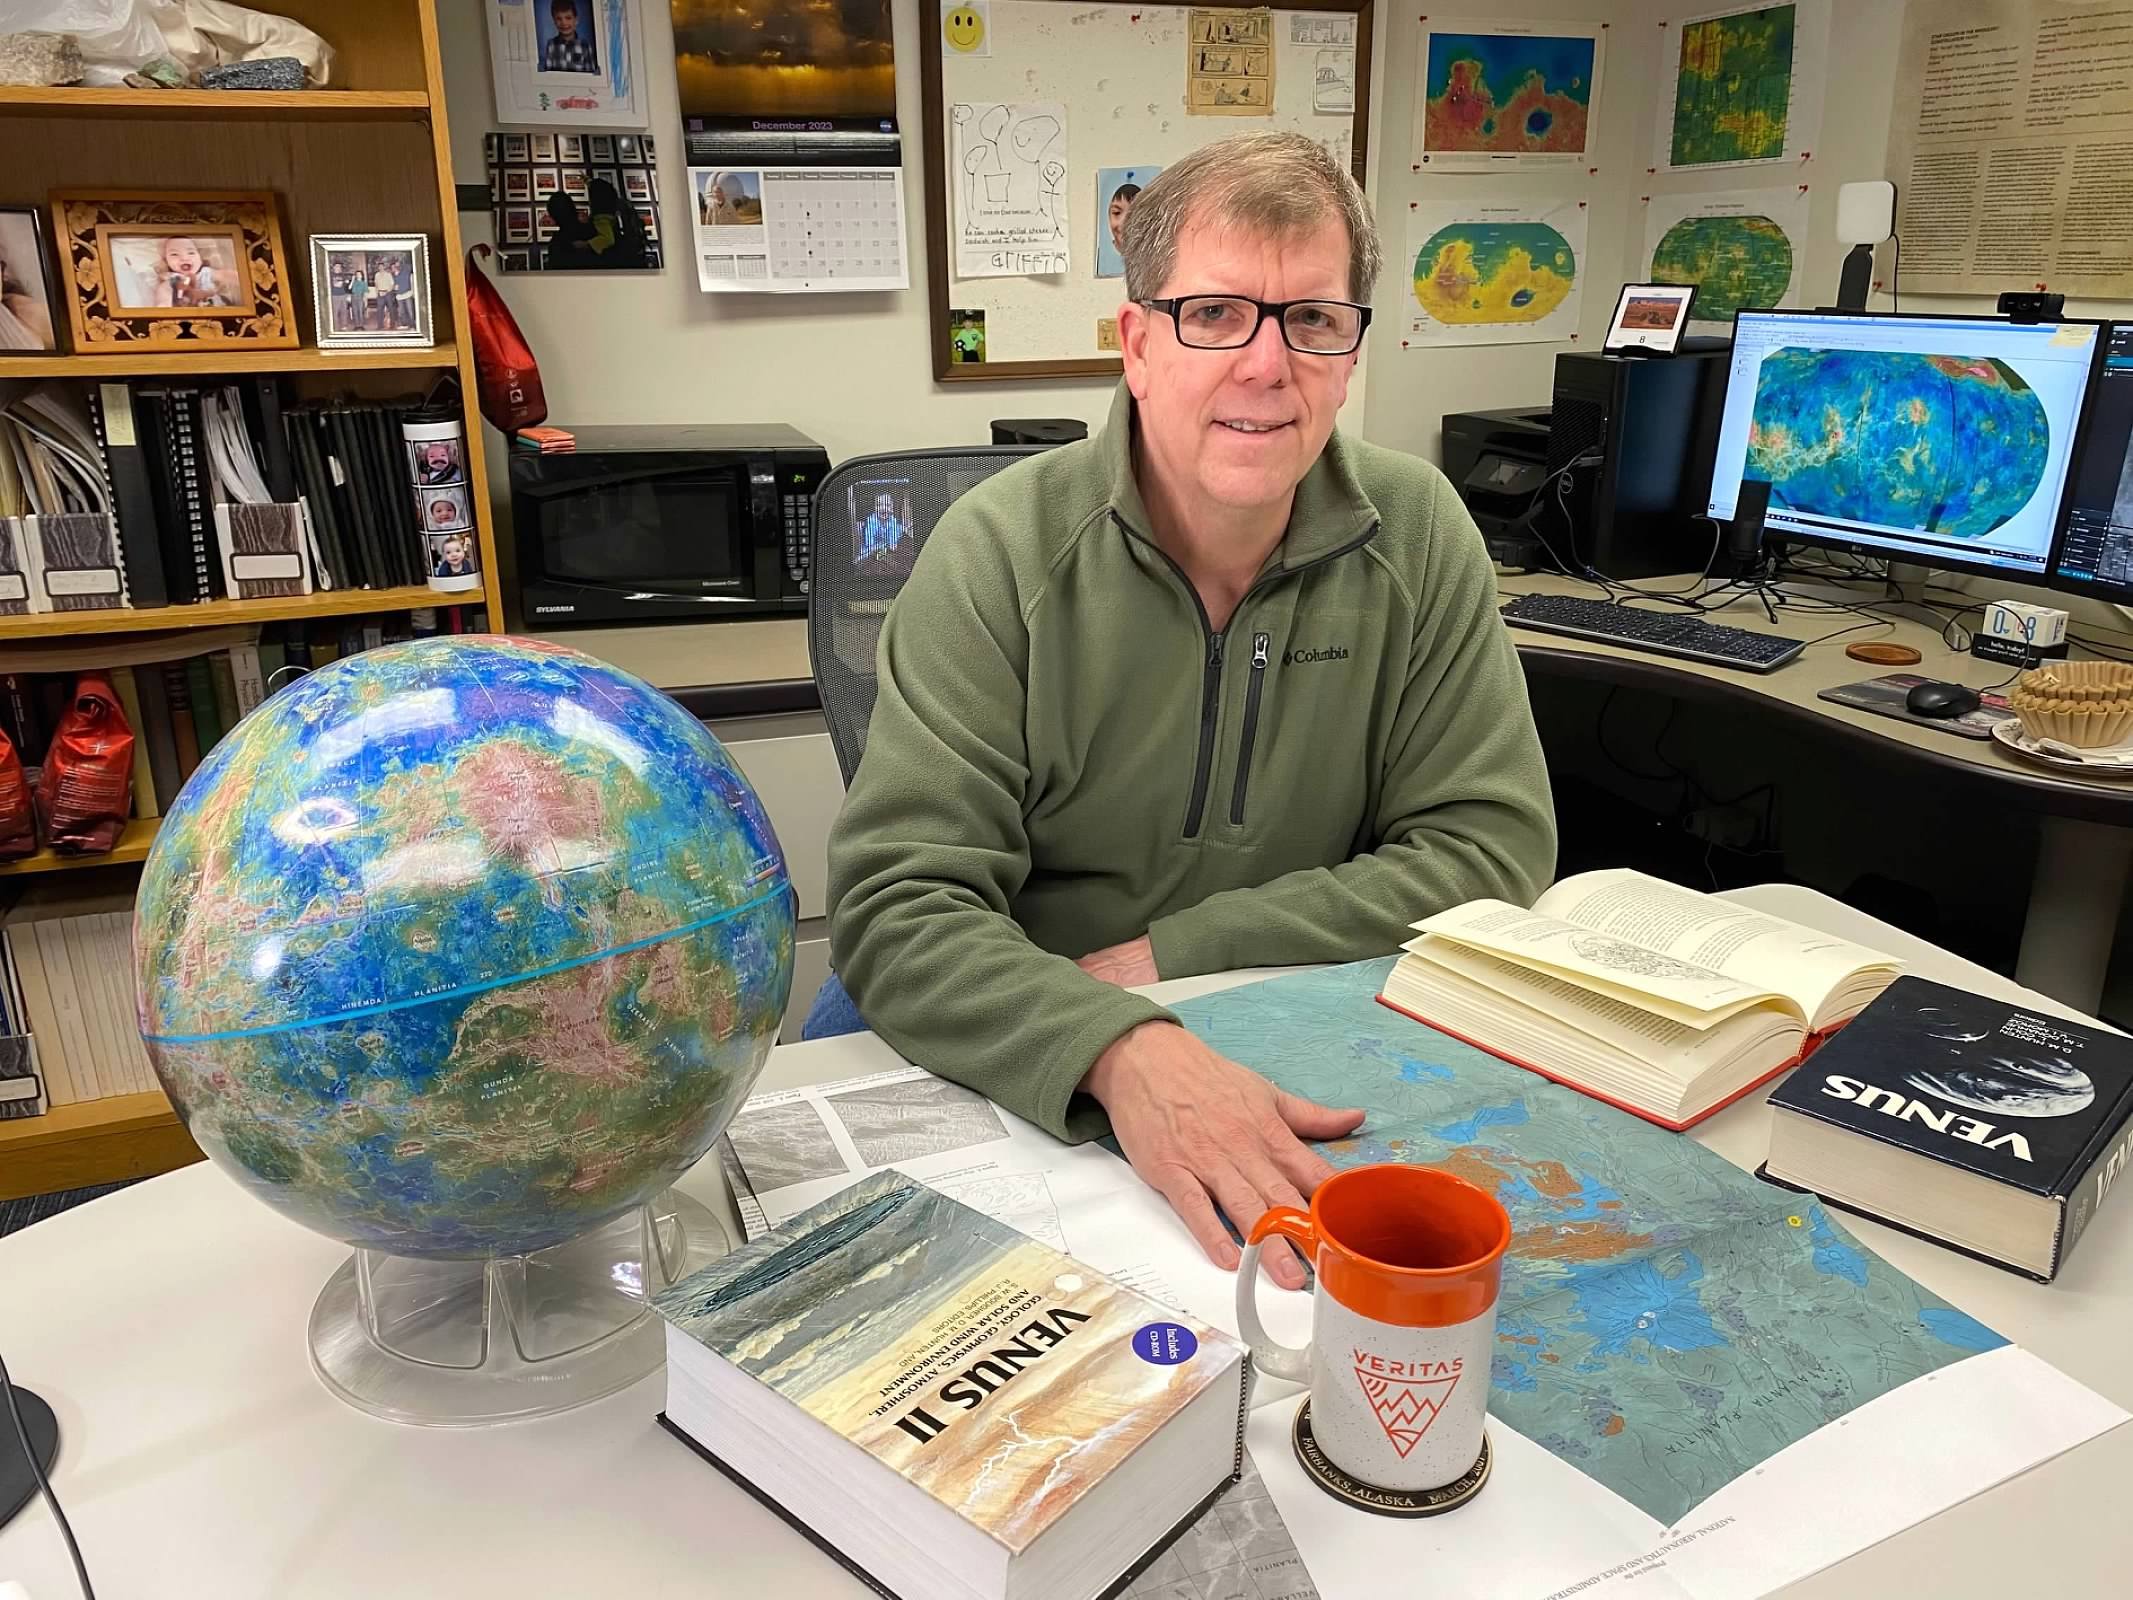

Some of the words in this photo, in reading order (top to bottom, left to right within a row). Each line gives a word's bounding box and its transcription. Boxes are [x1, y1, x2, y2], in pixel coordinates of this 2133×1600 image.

[752, 121, 806, 131] December
[808, 121, 833, 131] 2023
[1639, 335, 1646, 343] 8
[536, 605, 575, 613] SYLVANIA
[1993, 610, 2005, 633] 0
[2027, 616, 2037, 640] 8
[1294, 646, 1349, 664] Columbia
[414, 982, 457, 998] PLANITIA
[1999, 1028, 2046, 1045] HUNTEN
[483, 1076, 515, 1089] GUNDA
[1820, 1074, 2034, 1162] VENUS
[1008, 1288, 1030, 1306] AND
[931, 1310, 965, 1334] EDITORS
[979, 1306, 1010, 1328] SOLAR
[996, 1294, 1042, 1327] GEOLOGY,
[937, 1326, 999, 1369] GEOPHYSICS,
[950, 1326, 981, 1348] WIND
[1149, 1330, 1161, 1357] CD-ROM
[1166, 1328, 1180, 1360] Includes
[939, 1306, 1092, 1410] VENUS
[1353, 1349, 1464, 1377] VERITAS
[879, 1345, 952, 1398] ENVIRONMENT
[868, 1368, 939, 1417] ATMOSPHERE,
[894, 1406, 950, 1446] II
[1664, 1409, 1742, 1454] PLANITIA
[1302, 1436, 1352, 1493] FAIRBANKS,
[1353, 1487, 1416, 1507] ALASKA
[1427, 1477, 1477, 1505] MARCH,
[1698, 1515, 1737, 1538] NATIONAL
[1643, 1532, 1698, 1562] AERONAUTICS
[1253, 1558, 1299, 1573] PLANITIA
[1600, 1563, 1627, 1581] SPACE
[1626, 1556, 1644, 1570] AND
